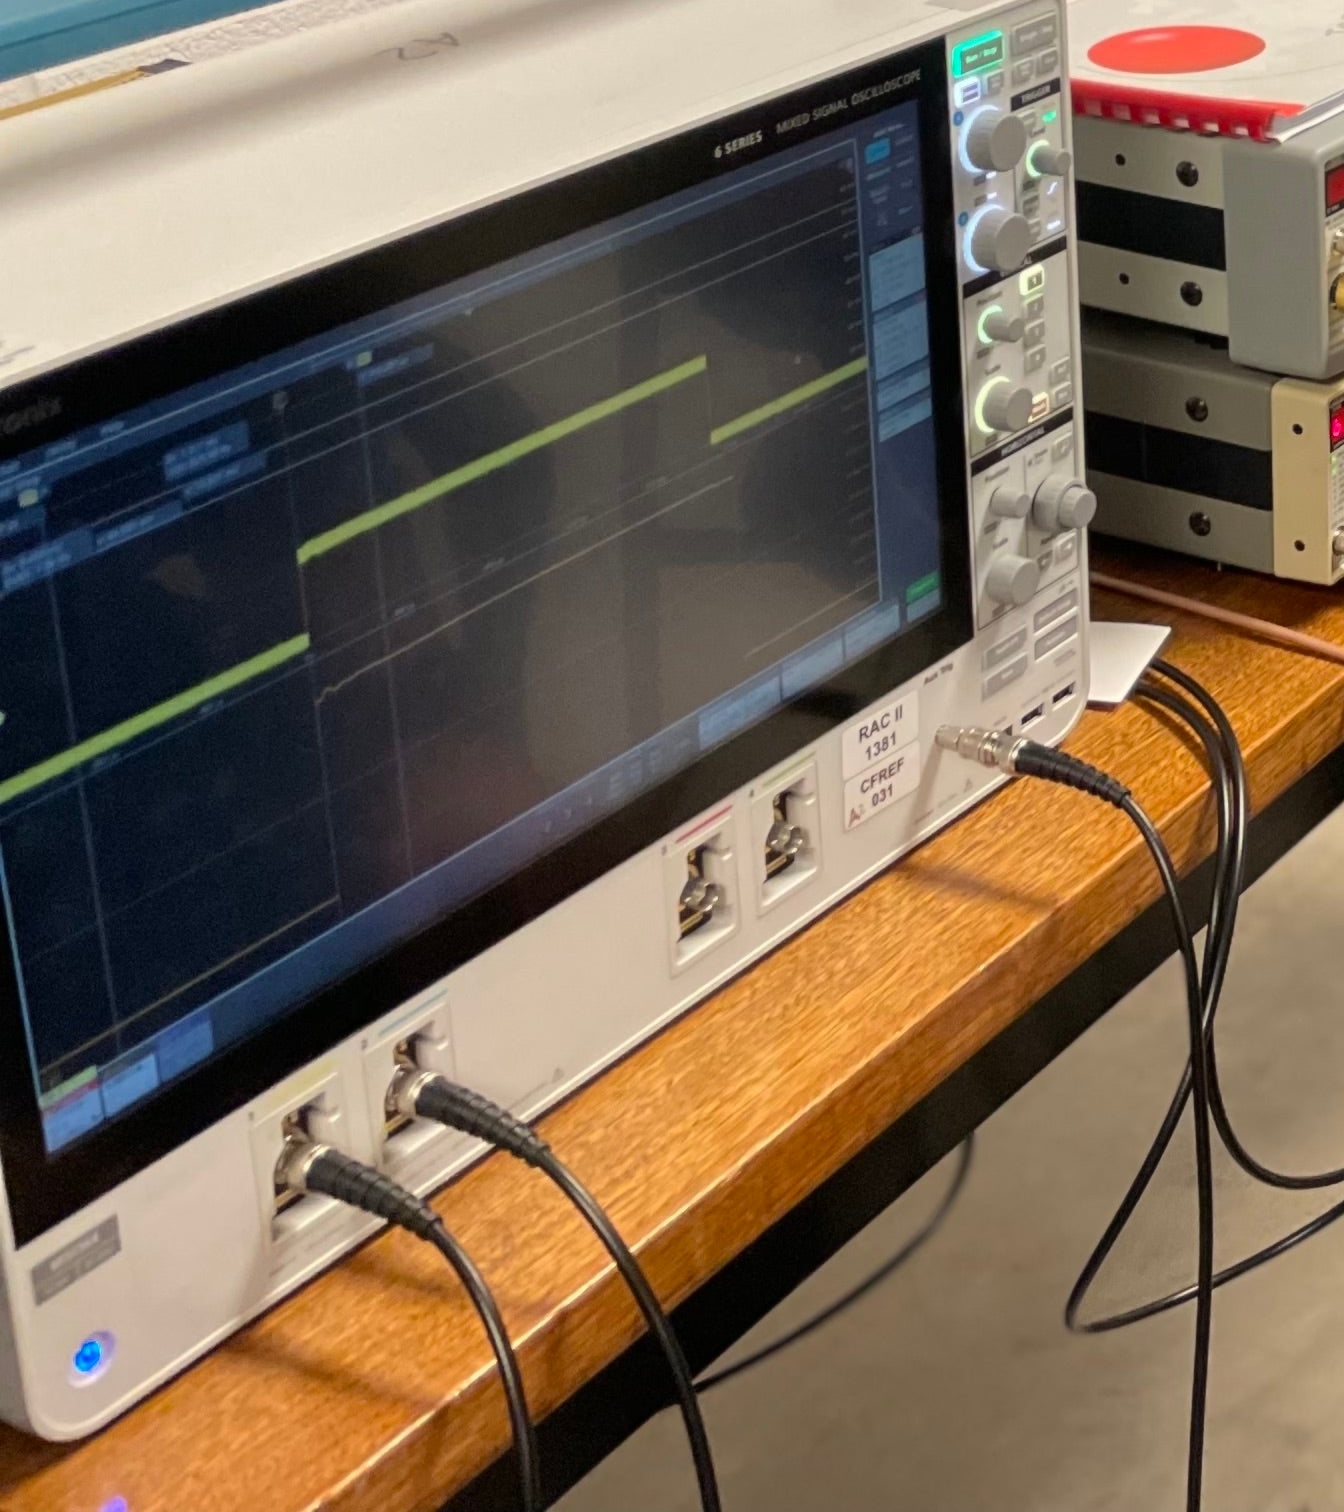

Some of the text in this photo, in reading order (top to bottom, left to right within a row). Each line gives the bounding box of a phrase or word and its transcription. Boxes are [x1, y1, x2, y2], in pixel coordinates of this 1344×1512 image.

[775, 67, 921, 135] MIXED SIGNAL OSCILLOSCOPE
[713, 129, 763, 159] 6 SERIES
[859, 713, 890, 743] RAC
[865, 731, 897, 761] 1381
[860, 757, 905, 794] CFREF
[871, 783, 893, 807] 031
